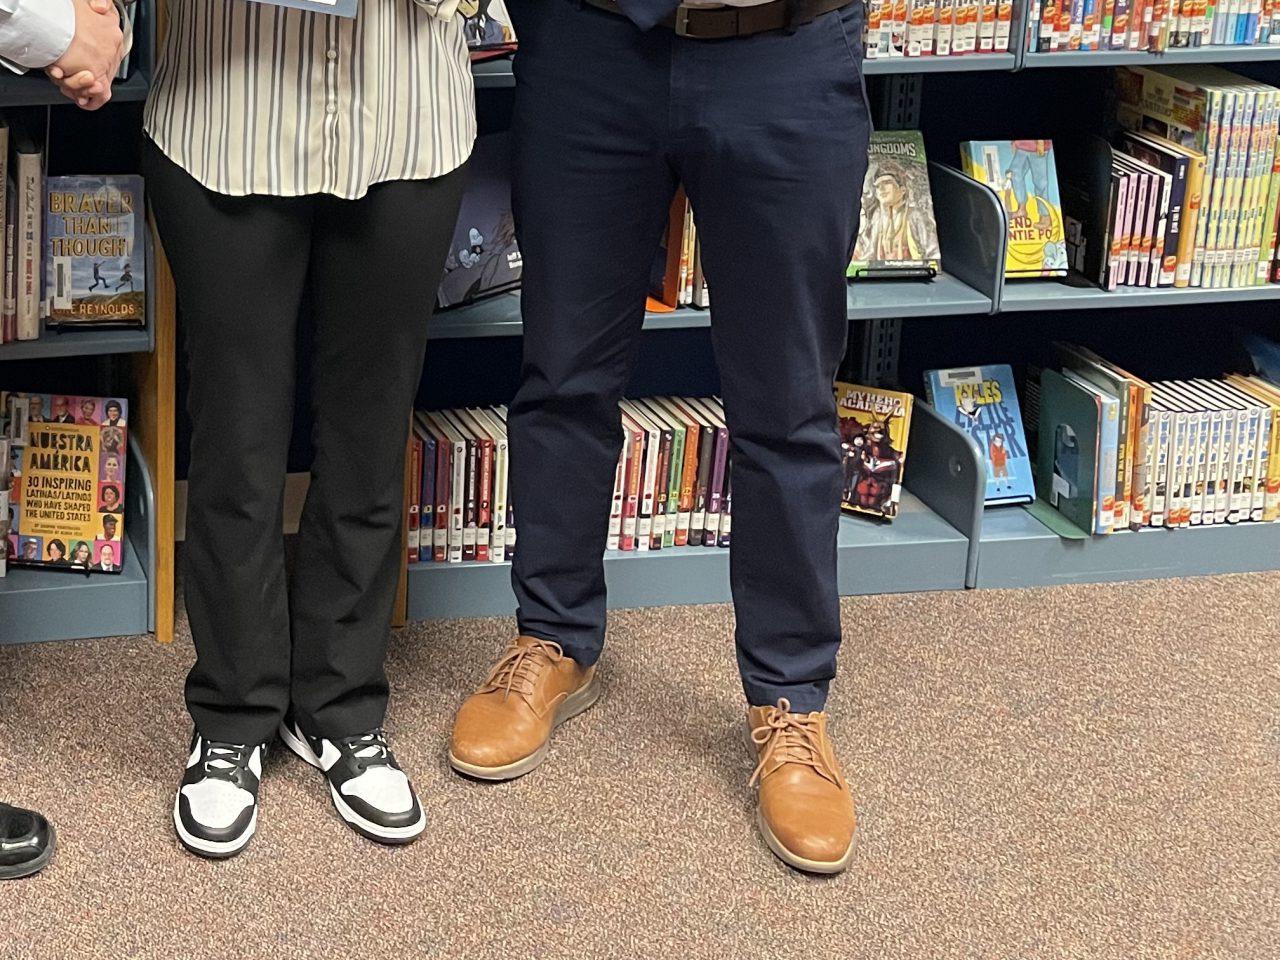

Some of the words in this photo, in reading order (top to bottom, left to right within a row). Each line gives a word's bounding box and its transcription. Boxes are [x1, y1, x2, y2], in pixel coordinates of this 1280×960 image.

[50, 192, 134, 214] BRAVER
[63, 216, 112, 235] THAN
[1008, 230, 1035, 240] NTIE
[1039, 230, 1051, 240] PO
[50, 238, 132, 256] THOUGHT
[80, 304, 135, 314] REYNOLDS
[846, 389, 866, 401] MY
[866, 393, 902, 407] HERO
[840, 398, 905, 417] ACADEMIA
[30, 431, 93, 452] NUESTRA
[30, 450, 91, 473] AMÉRICA
[28, 476, 39, 488] 30
[42, 477, 92, 491] INSPIRING
[26, 489, 92, 502] LATINAS/LATINOS
[26, 500, 42, 510] WHO
[43, 501, 62, 510] HAVE
[63, 502, 91, 512] SHAPED
[25, 509, 38, 518] THE
[39, 510, 64, 520] UNITED
[65, 512, 91, 522] STATES
